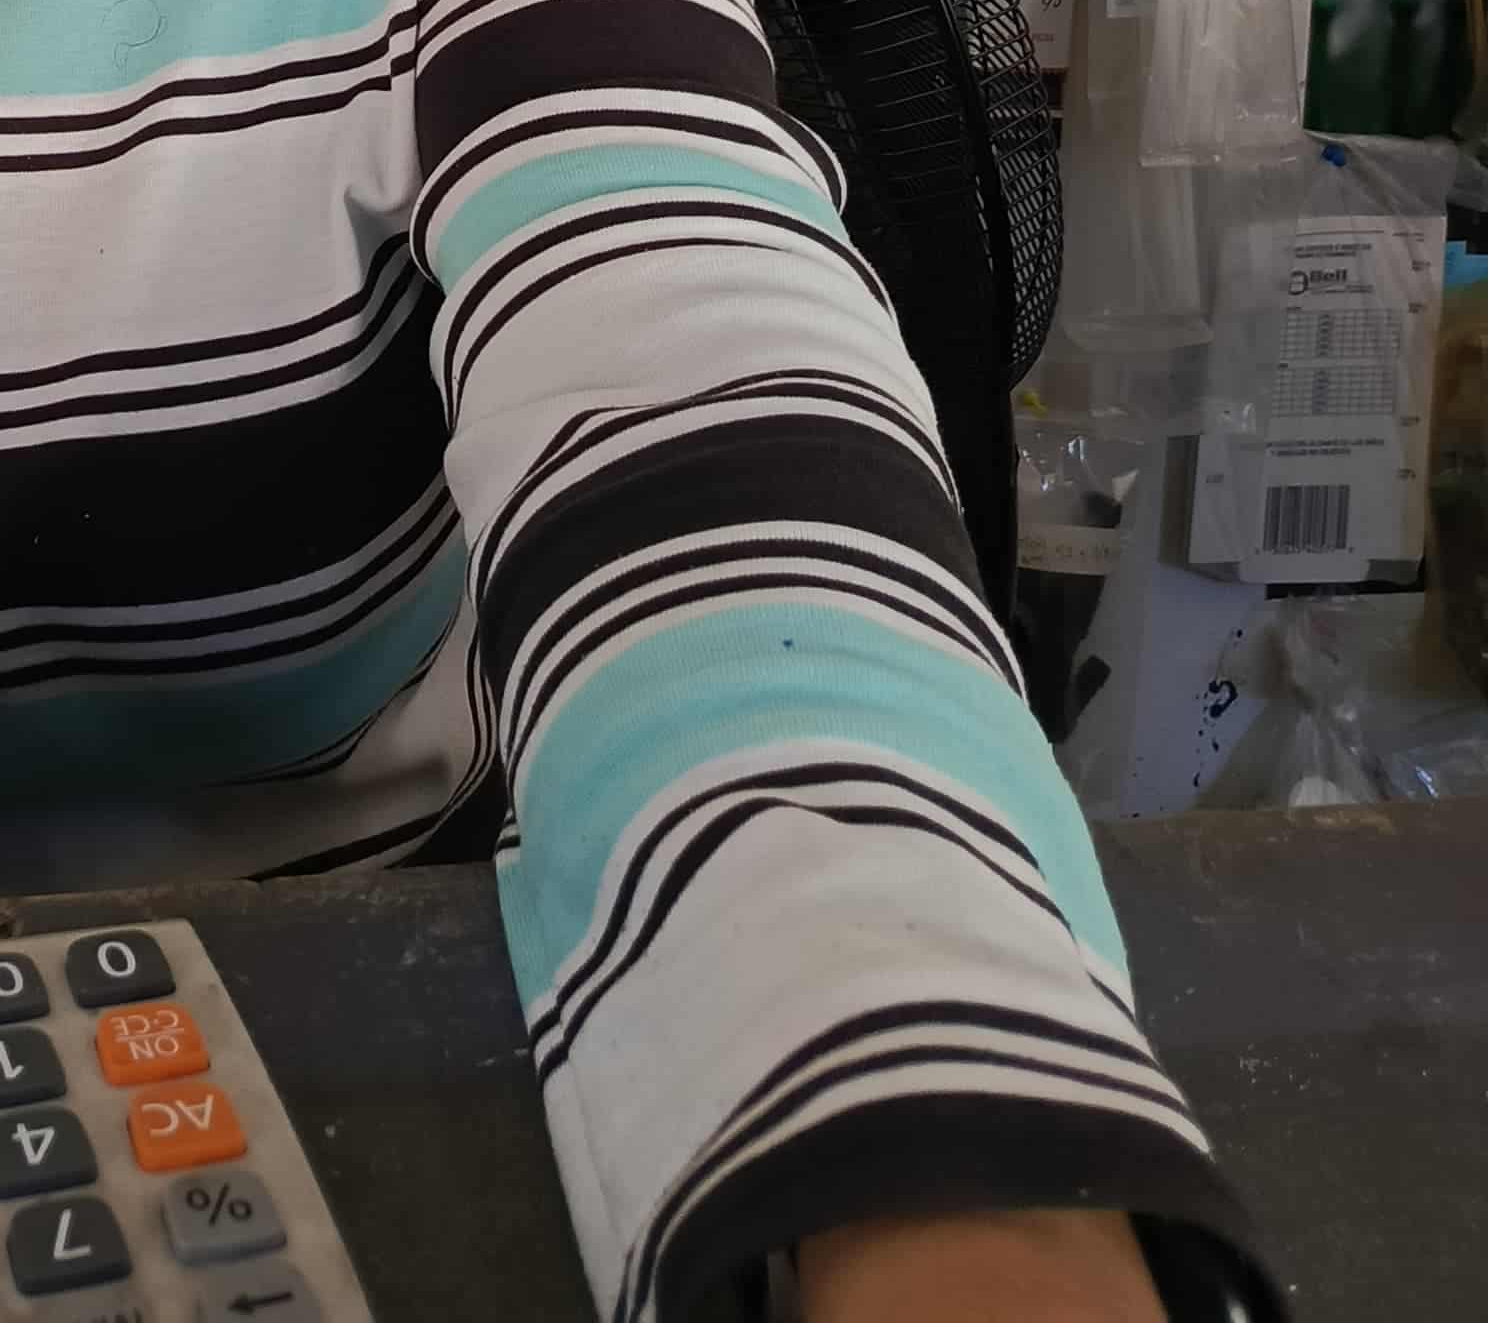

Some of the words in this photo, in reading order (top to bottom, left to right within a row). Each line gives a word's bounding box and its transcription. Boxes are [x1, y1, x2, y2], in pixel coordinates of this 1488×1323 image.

[97, 941, 136, 978] 0
[11, 1122, 57, 1163] 4
[141, 1099, 214, 1138] AC
[52, 1210, 93, 1260] 7
